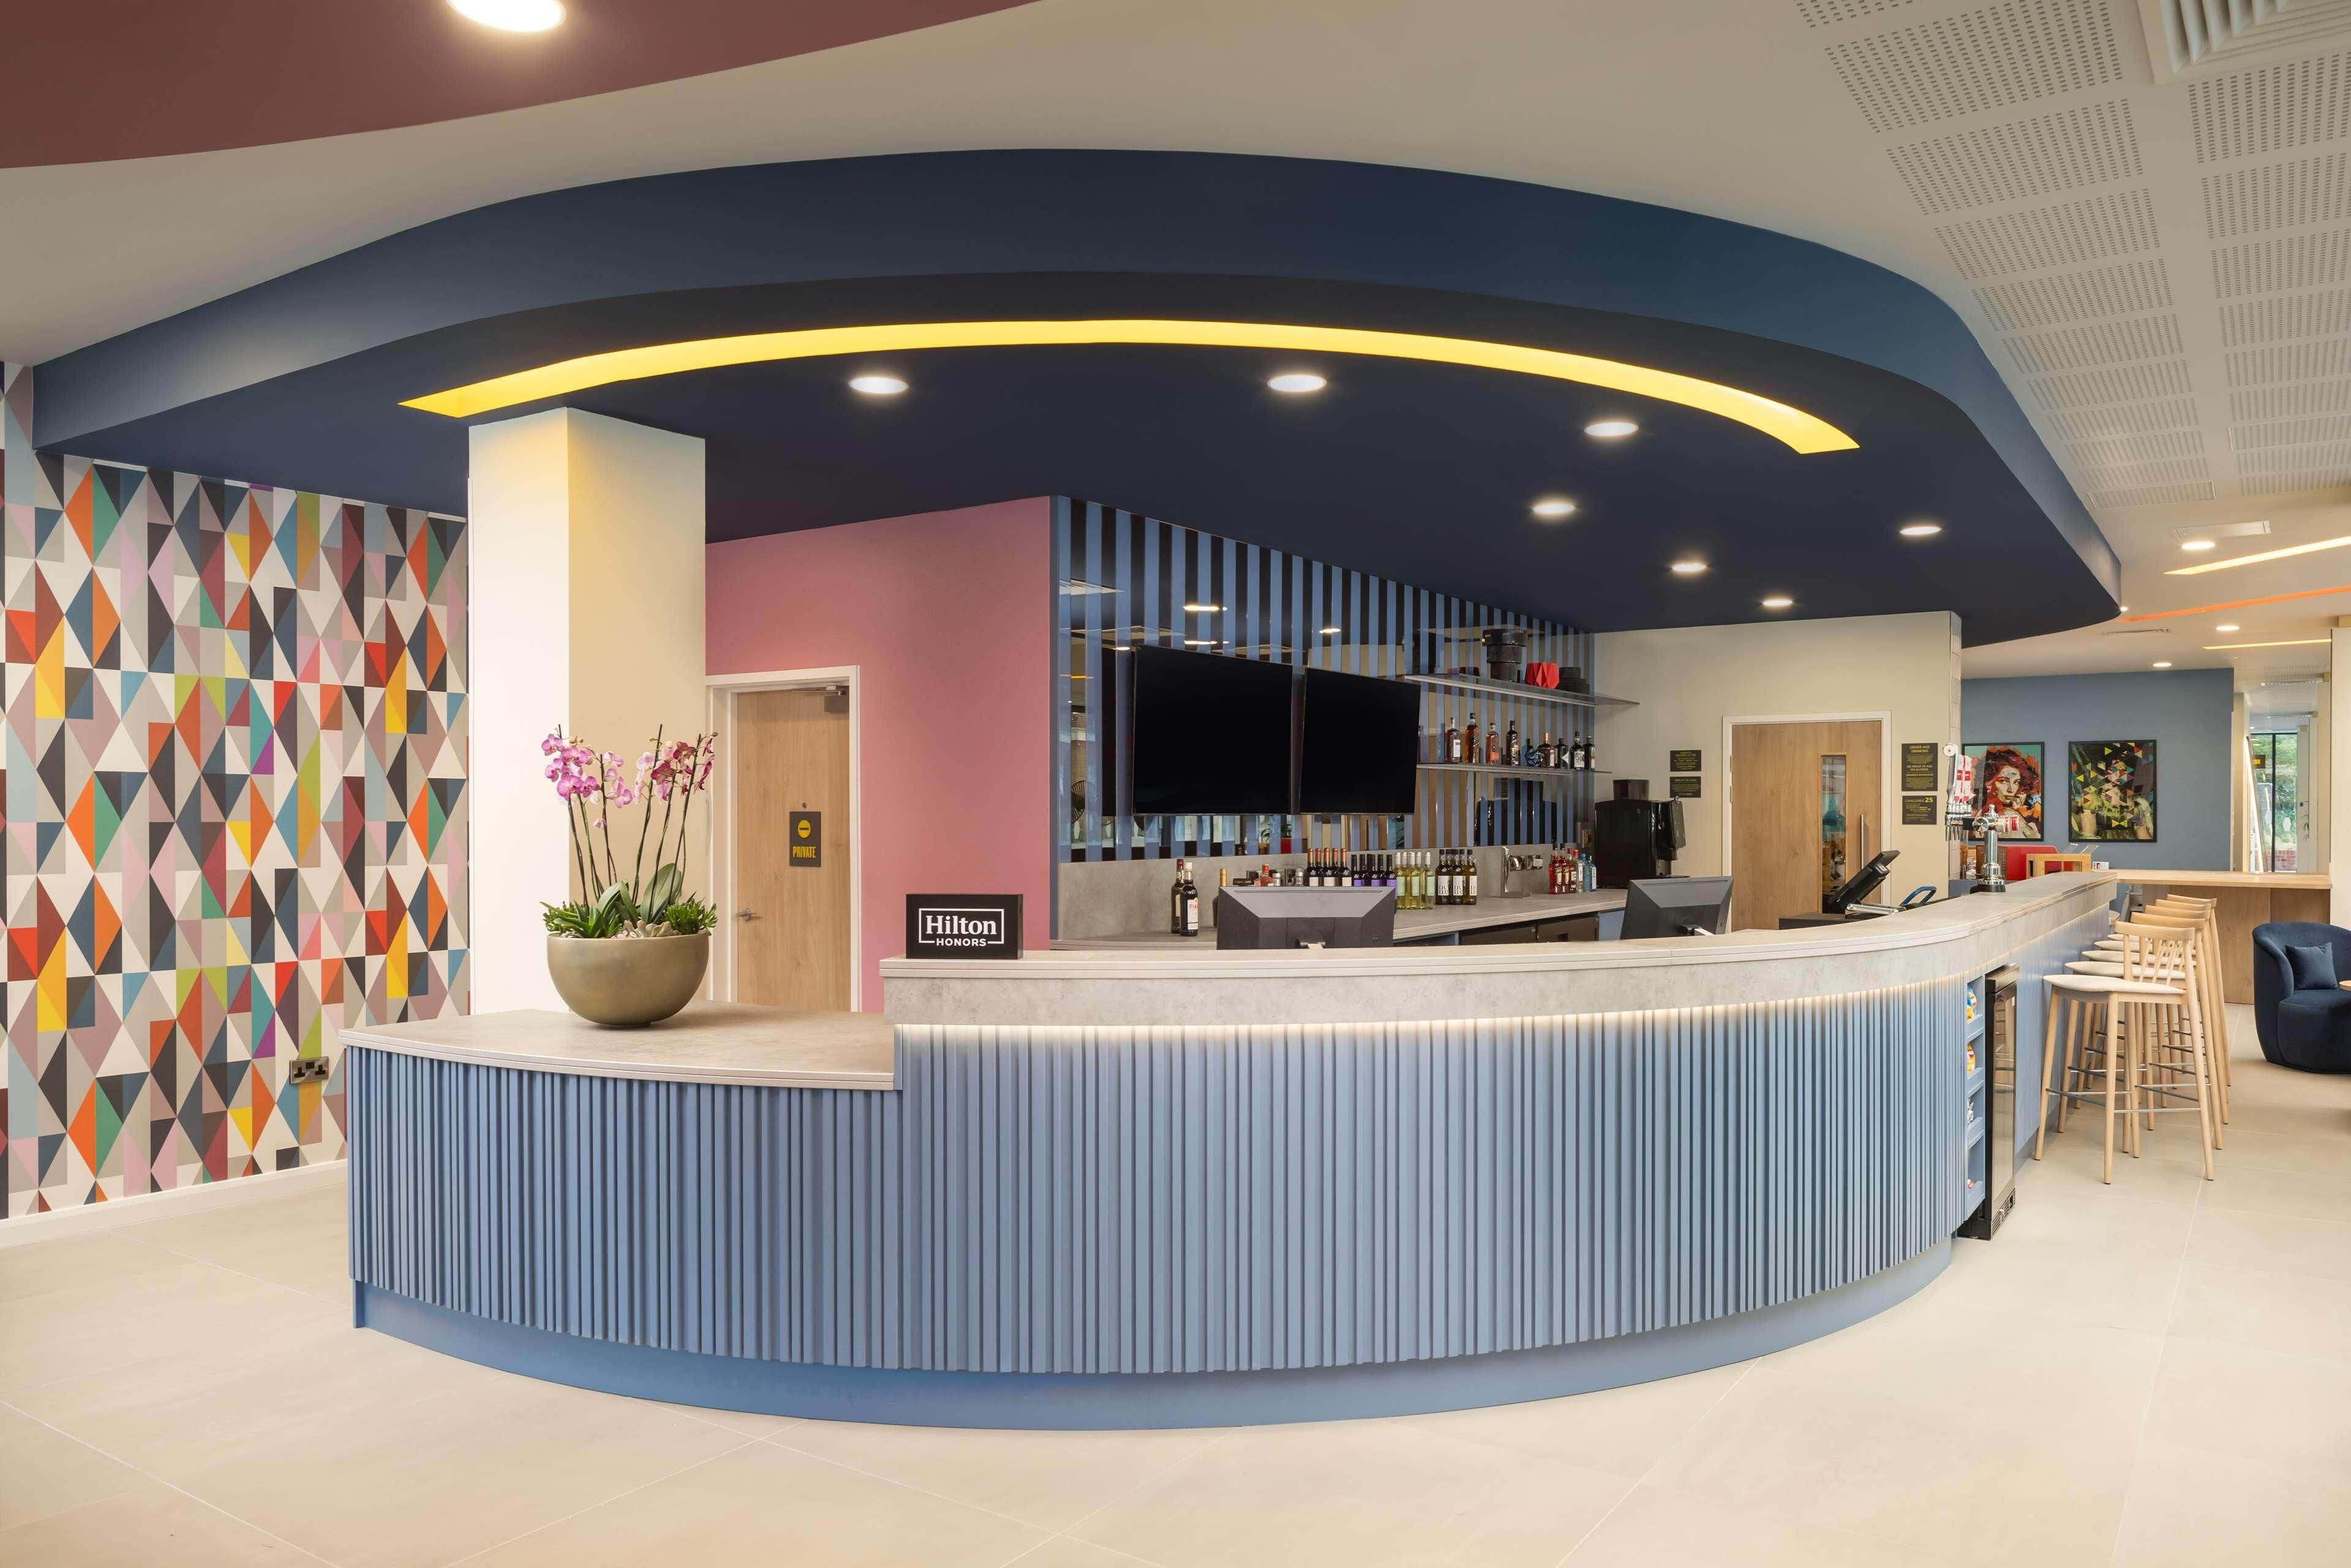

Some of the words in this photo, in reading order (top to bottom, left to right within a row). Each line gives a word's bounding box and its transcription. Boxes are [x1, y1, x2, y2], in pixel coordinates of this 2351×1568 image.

[792, 846, 816, 858] PRIVATE
[926, 915, 997, 935] Hilton
[936, 938, 987, 947] HONORS
